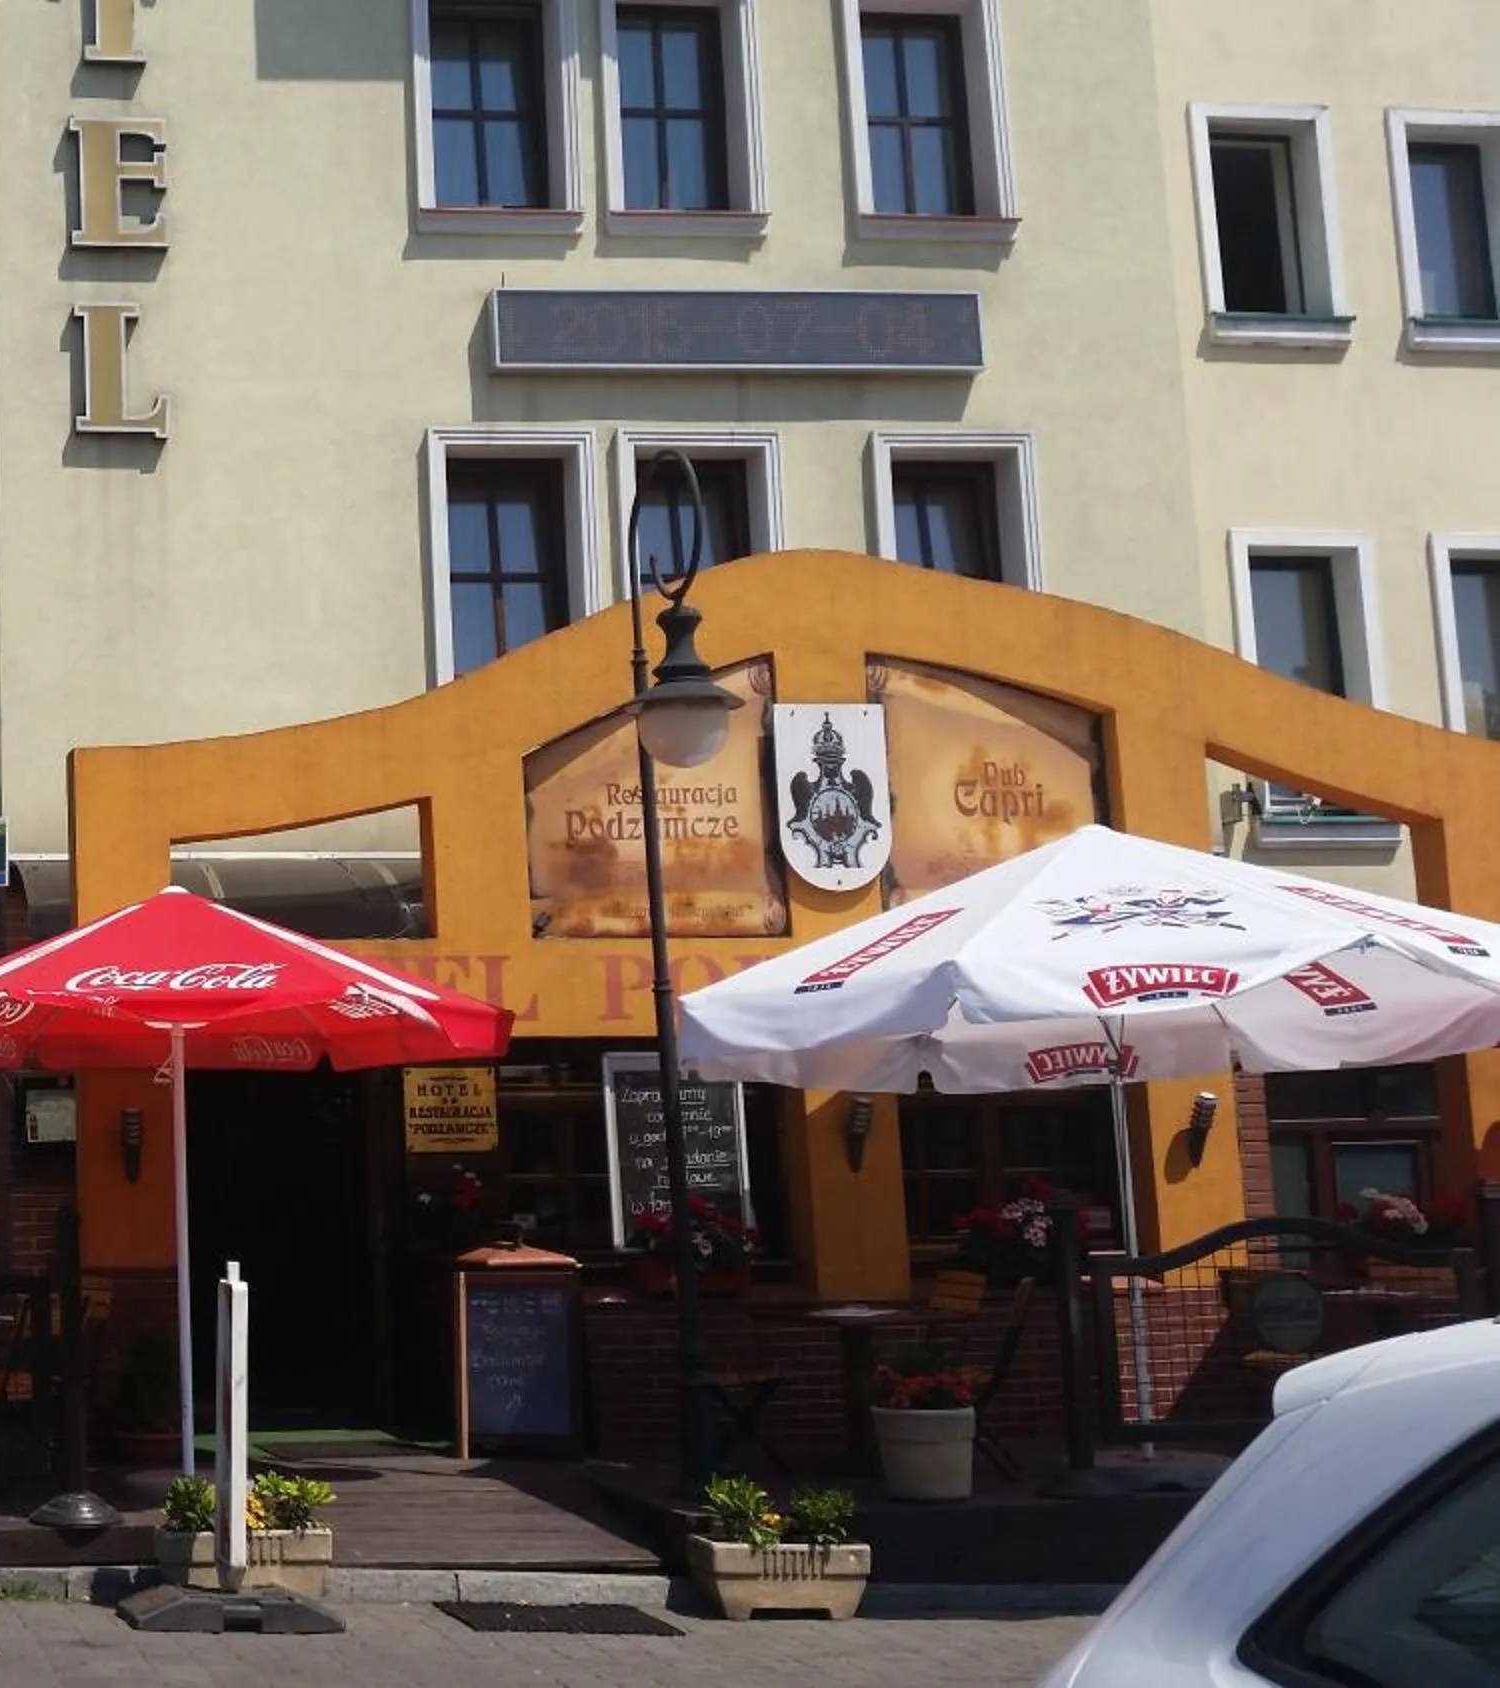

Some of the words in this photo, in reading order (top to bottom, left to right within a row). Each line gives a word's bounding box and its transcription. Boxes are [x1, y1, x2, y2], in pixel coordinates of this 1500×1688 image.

[983, 761, 1026, 788] Pub
[606, 783, 739, 807] Resauracja
[954, 779, 1044, 826] Capri
[565, 810, 740, 847] Podzmcze
[65, 962, 289, 992] Coca-Cola
[1101, 966, 1221, 995] ŻYWIEC
[417, 1083, 483, 1096] HOTEL
